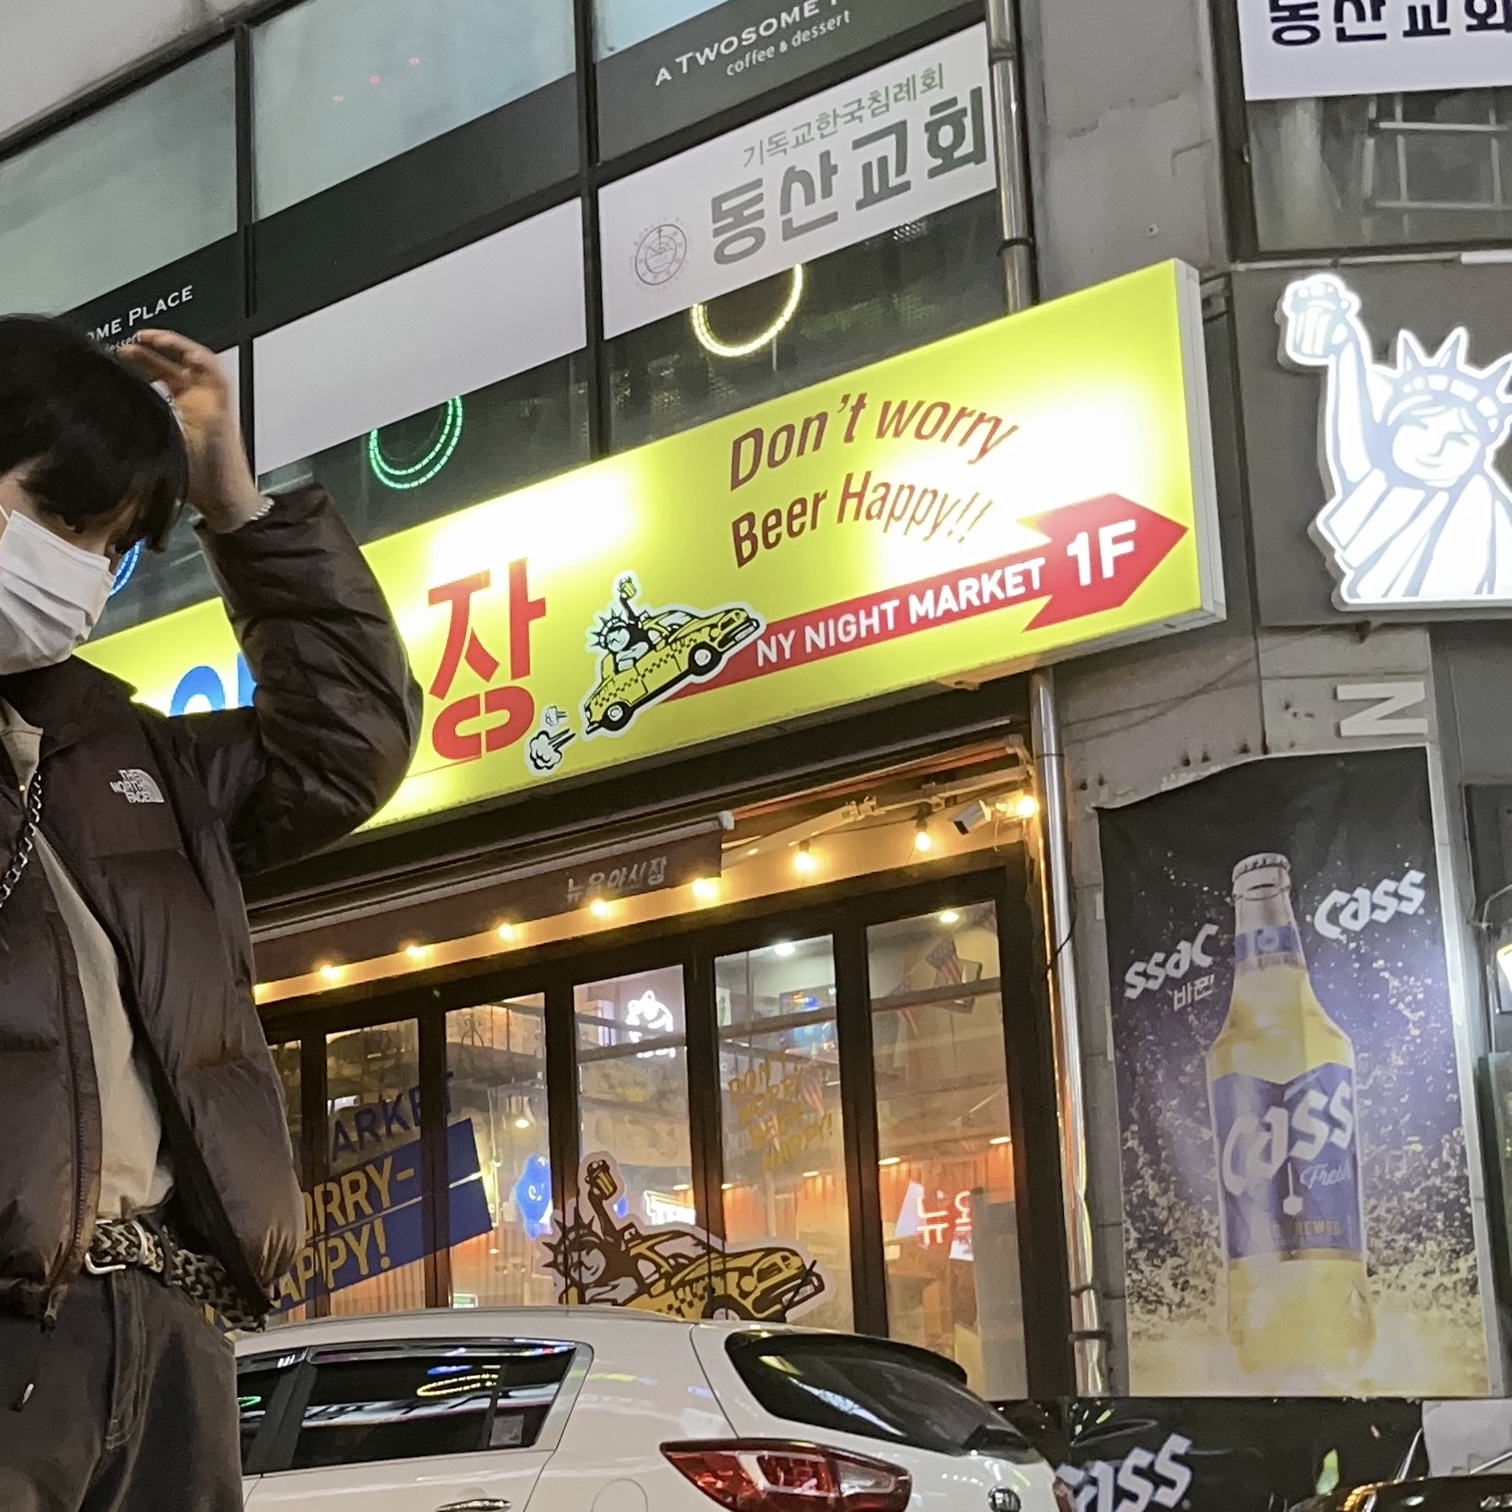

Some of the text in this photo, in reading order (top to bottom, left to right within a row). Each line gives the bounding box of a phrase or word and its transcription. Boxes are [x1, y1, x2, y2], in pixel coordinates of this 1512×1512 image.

[654, 0, 820, 86] A TWOSOME
[726, 47, 775, 76] coffee
[791, 10, 851, 48] dessert
[743, 63, 944, 168] 기독교한국침례회
[712, 86, 987, 264] 동산교회
[128, 285, 193, 327] PLACE
[730, 392, 1020, 491] Don't worry
[731, 470, 994, 569] Beer Happy!!
[756, 520, 1141, 667] NY NIGHT MARKET 1F
[1313, 869, 1426, 941] Cass
[1222, 1079, 1354, 1196] Cass
